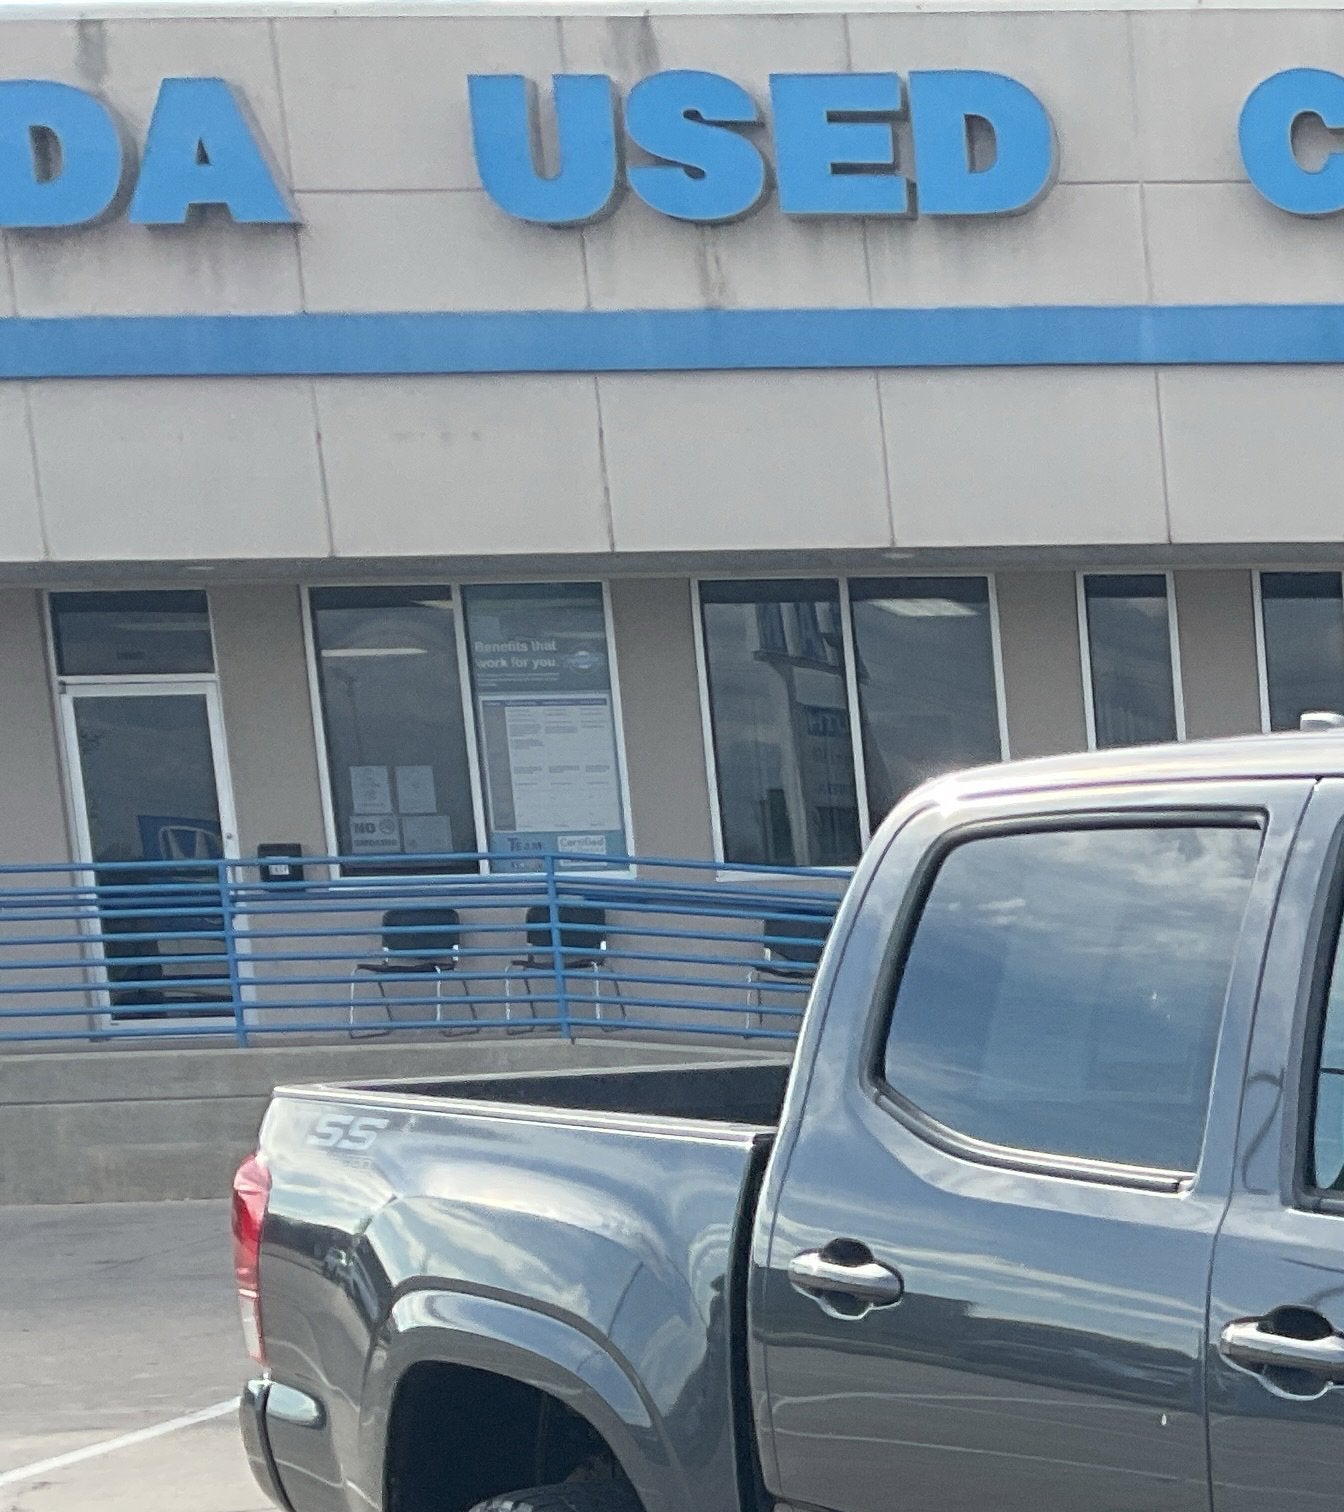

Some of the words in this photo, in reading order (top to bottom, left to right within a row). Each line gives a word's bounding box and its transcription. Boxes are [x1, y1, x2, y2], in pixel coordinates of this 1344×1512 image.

[0, 77, 298, 228] DA
[466, 69, 1055, 224] USED
[474, 641, 529, 652] Benefits
[531, 640, 558, 652] that
[476, 657, 508, 669] work
[511, 657, 528, 668] for
[354, 823, 376, 834] NO
